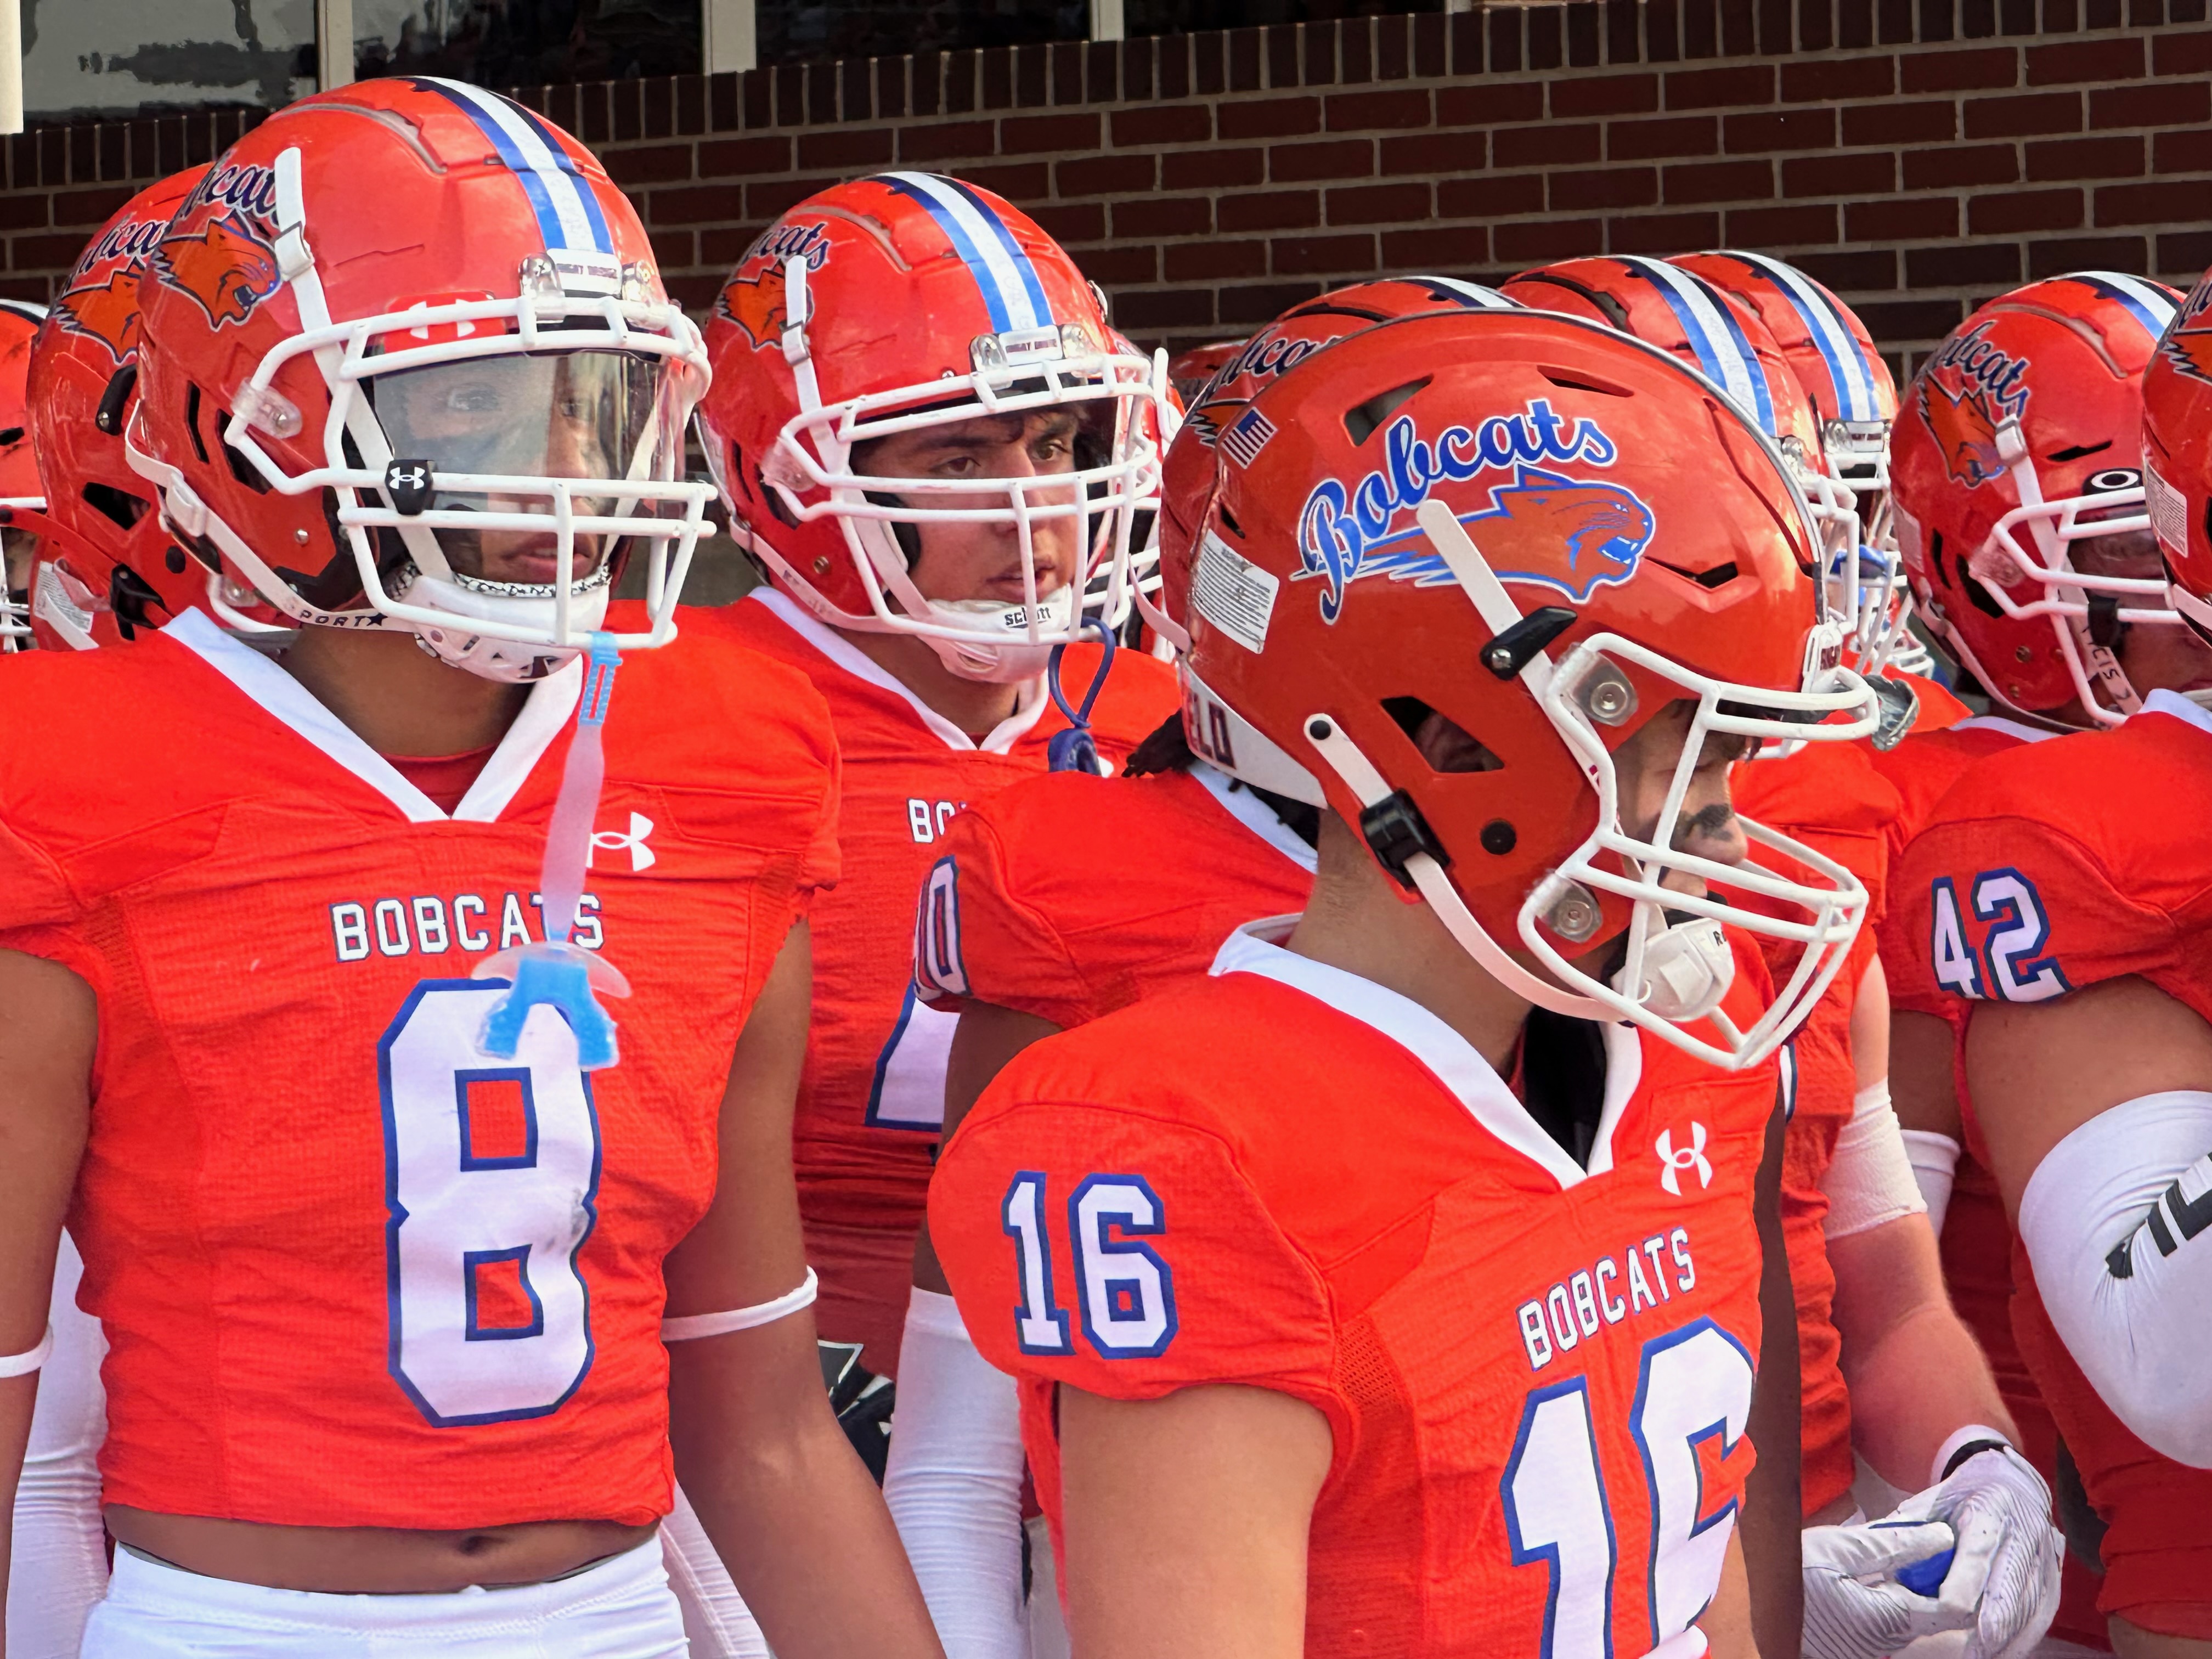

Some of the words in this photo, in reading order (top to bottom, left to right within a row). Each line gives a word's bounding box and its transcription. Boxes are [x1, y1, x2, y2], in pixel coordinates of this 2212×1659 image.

[1297, 398, 1617, 625] Bobcats
[329, 891, 606, 963] BOBCAS
[1931, 866, 2075, 1003] 42
[377, 977, 602, 1428] 8
[1001, 1170, 1180, 1359] 16
[1515, 1226, 1696, 1372] BOBCATS
[1499, 1315, 1756, 1659] 16
